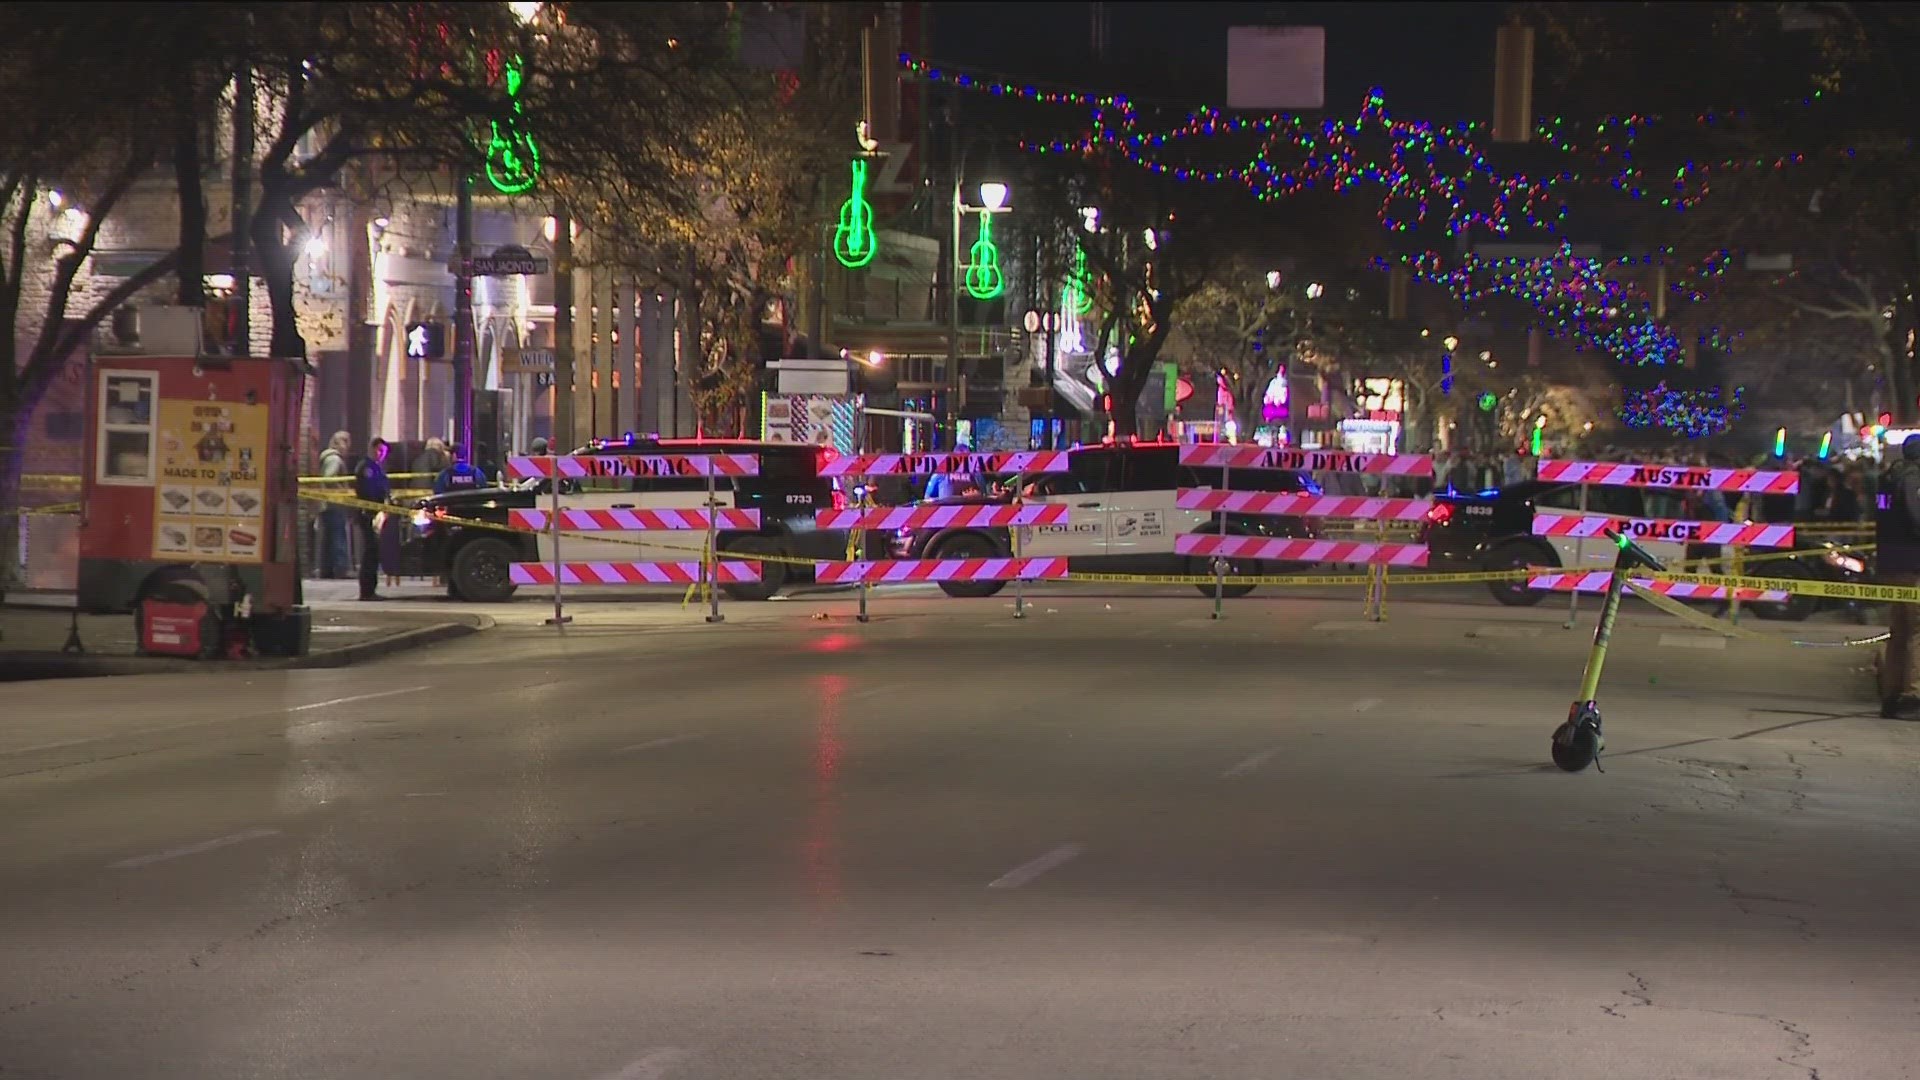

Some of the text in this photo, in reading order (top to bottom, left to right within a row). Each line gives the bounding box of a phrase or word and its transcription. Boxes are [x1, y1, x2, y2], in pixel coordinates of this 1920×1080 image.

[475, 260, 496, 273] SAN
[498, 260, 535, 273] JACINTO
[585, 458, 690, 476] APD DTAC
[895, 455, 1001, 473] APD DTAC
[1261, 451, 1367, 472] APD DTAC
[164, 468, 196, 477] MADE
[200, 470, 214, 479] TO
[1632, 468, 1711, 486] AUSTIN
[786, 495, 812, 504] 8733
[1039, 524, 1102, 534] POLICE
[1618, 520, 1702, 540] POLICE
